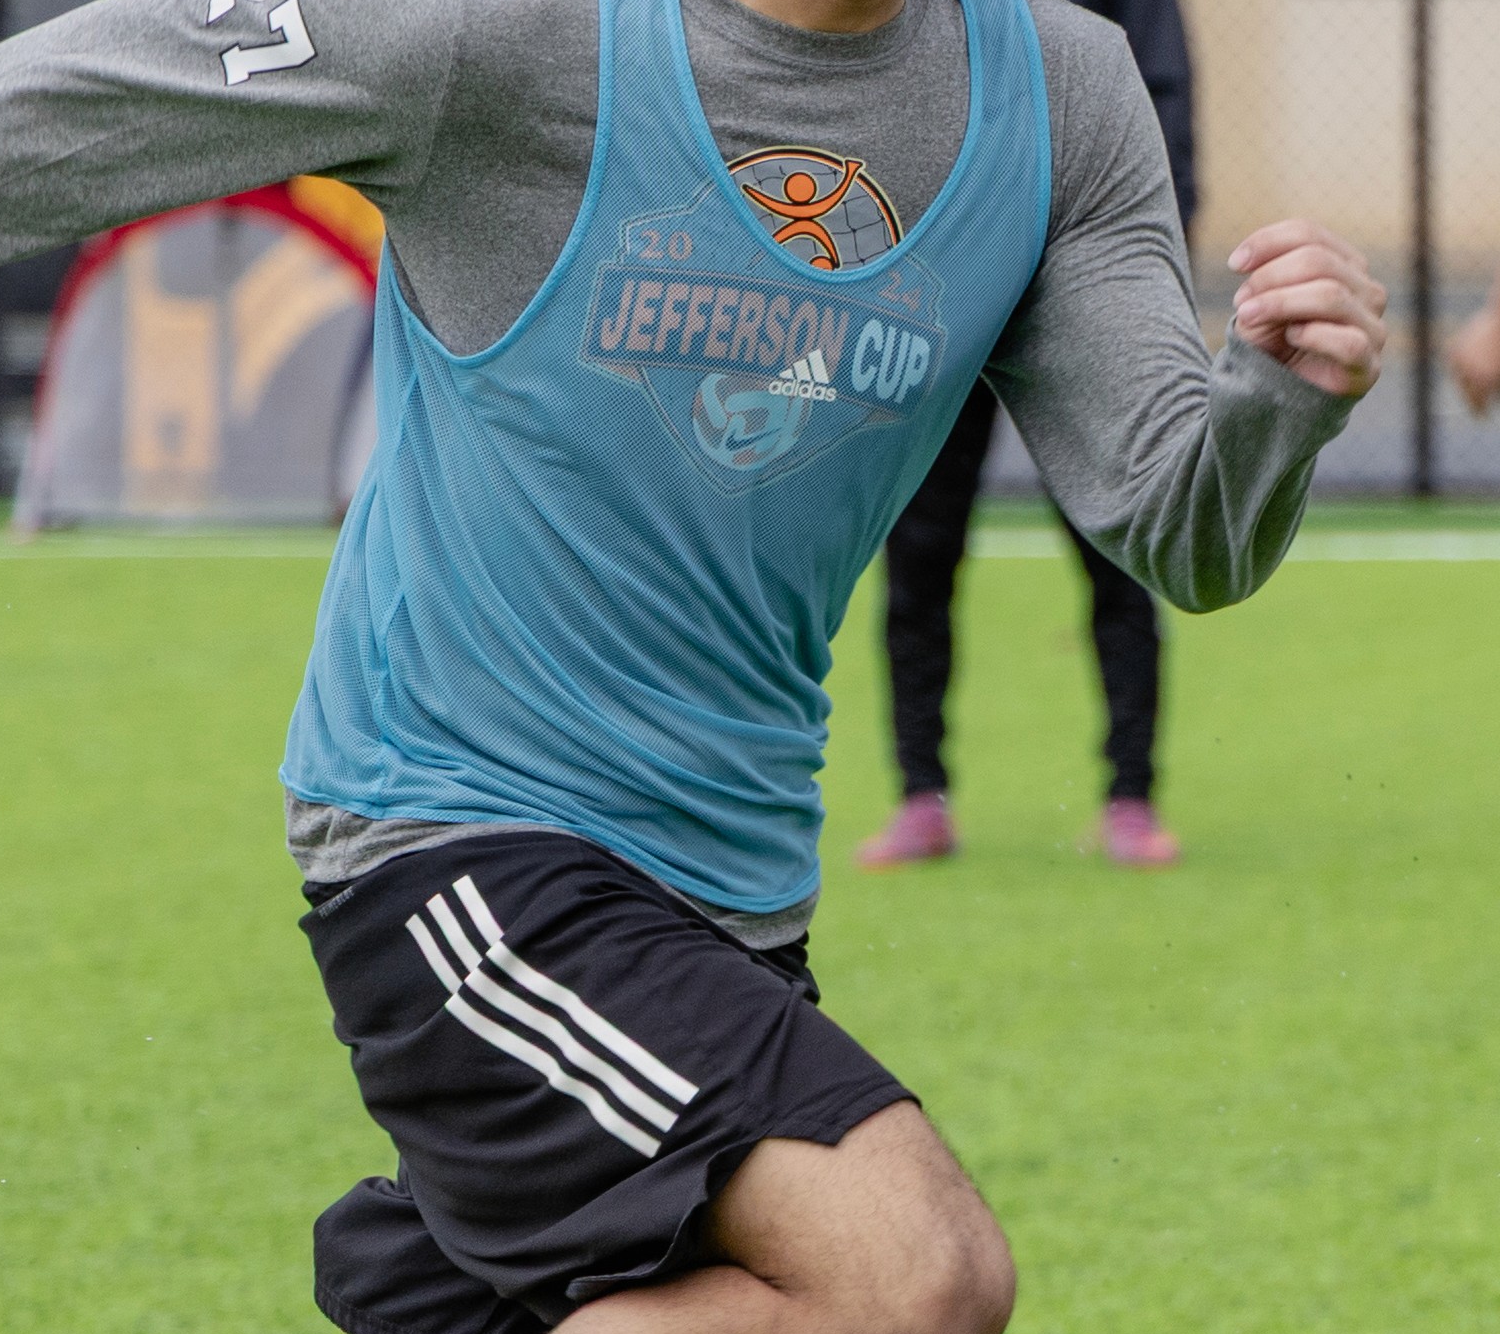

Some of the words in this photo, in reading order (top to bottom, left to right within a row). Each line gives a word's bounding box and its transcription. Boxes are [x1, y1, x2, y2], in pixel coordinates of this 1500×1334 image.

[639, 229, 693, 262] 20
[600, 278, 849, 380] JEFFERSON
[852, 319, 931, 404] CUP
[768, 377, 837, 402] adidas
